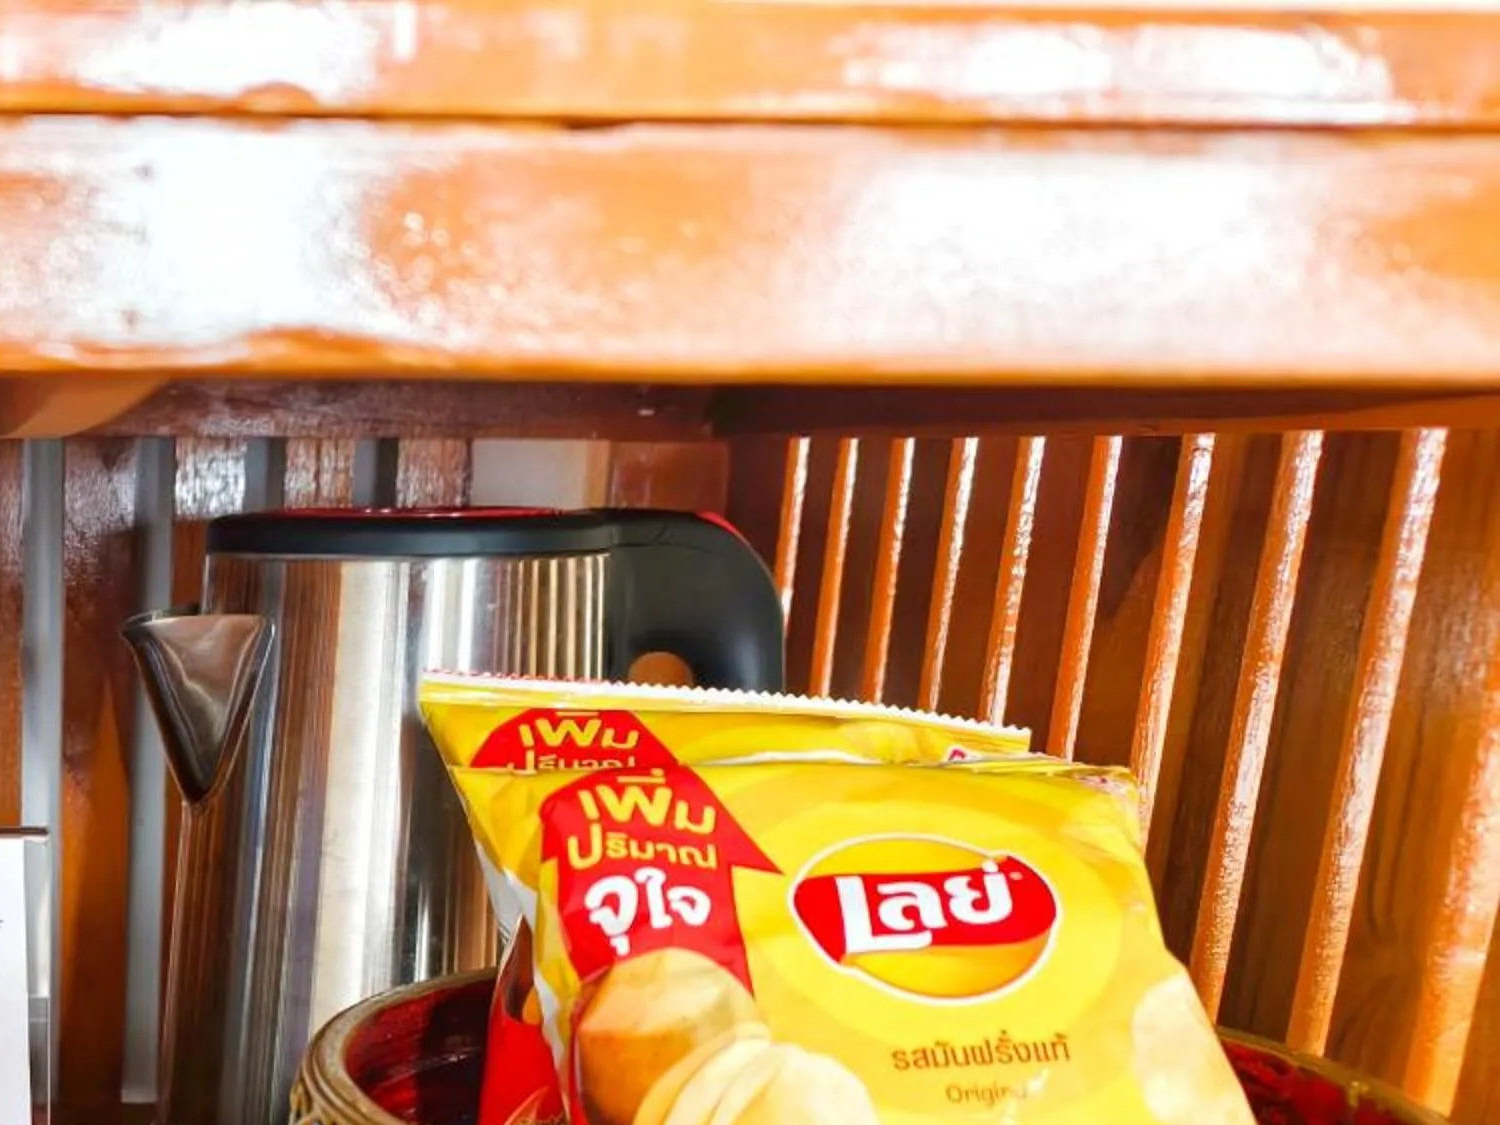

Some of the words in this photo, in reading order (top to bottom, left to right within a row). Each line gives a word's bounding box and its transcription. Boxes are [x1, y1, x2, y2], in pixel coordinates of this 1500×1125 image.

[577, 768, 716, 834] เพิ่ม
[567, 822, 717, 870] ปริมาณ
[585, 867, 712, 956] จุใจ
[833, 858, 1013, 957] เลย์
[891, 1030, 1071, 1071] รสมันฝรั่งแท้
